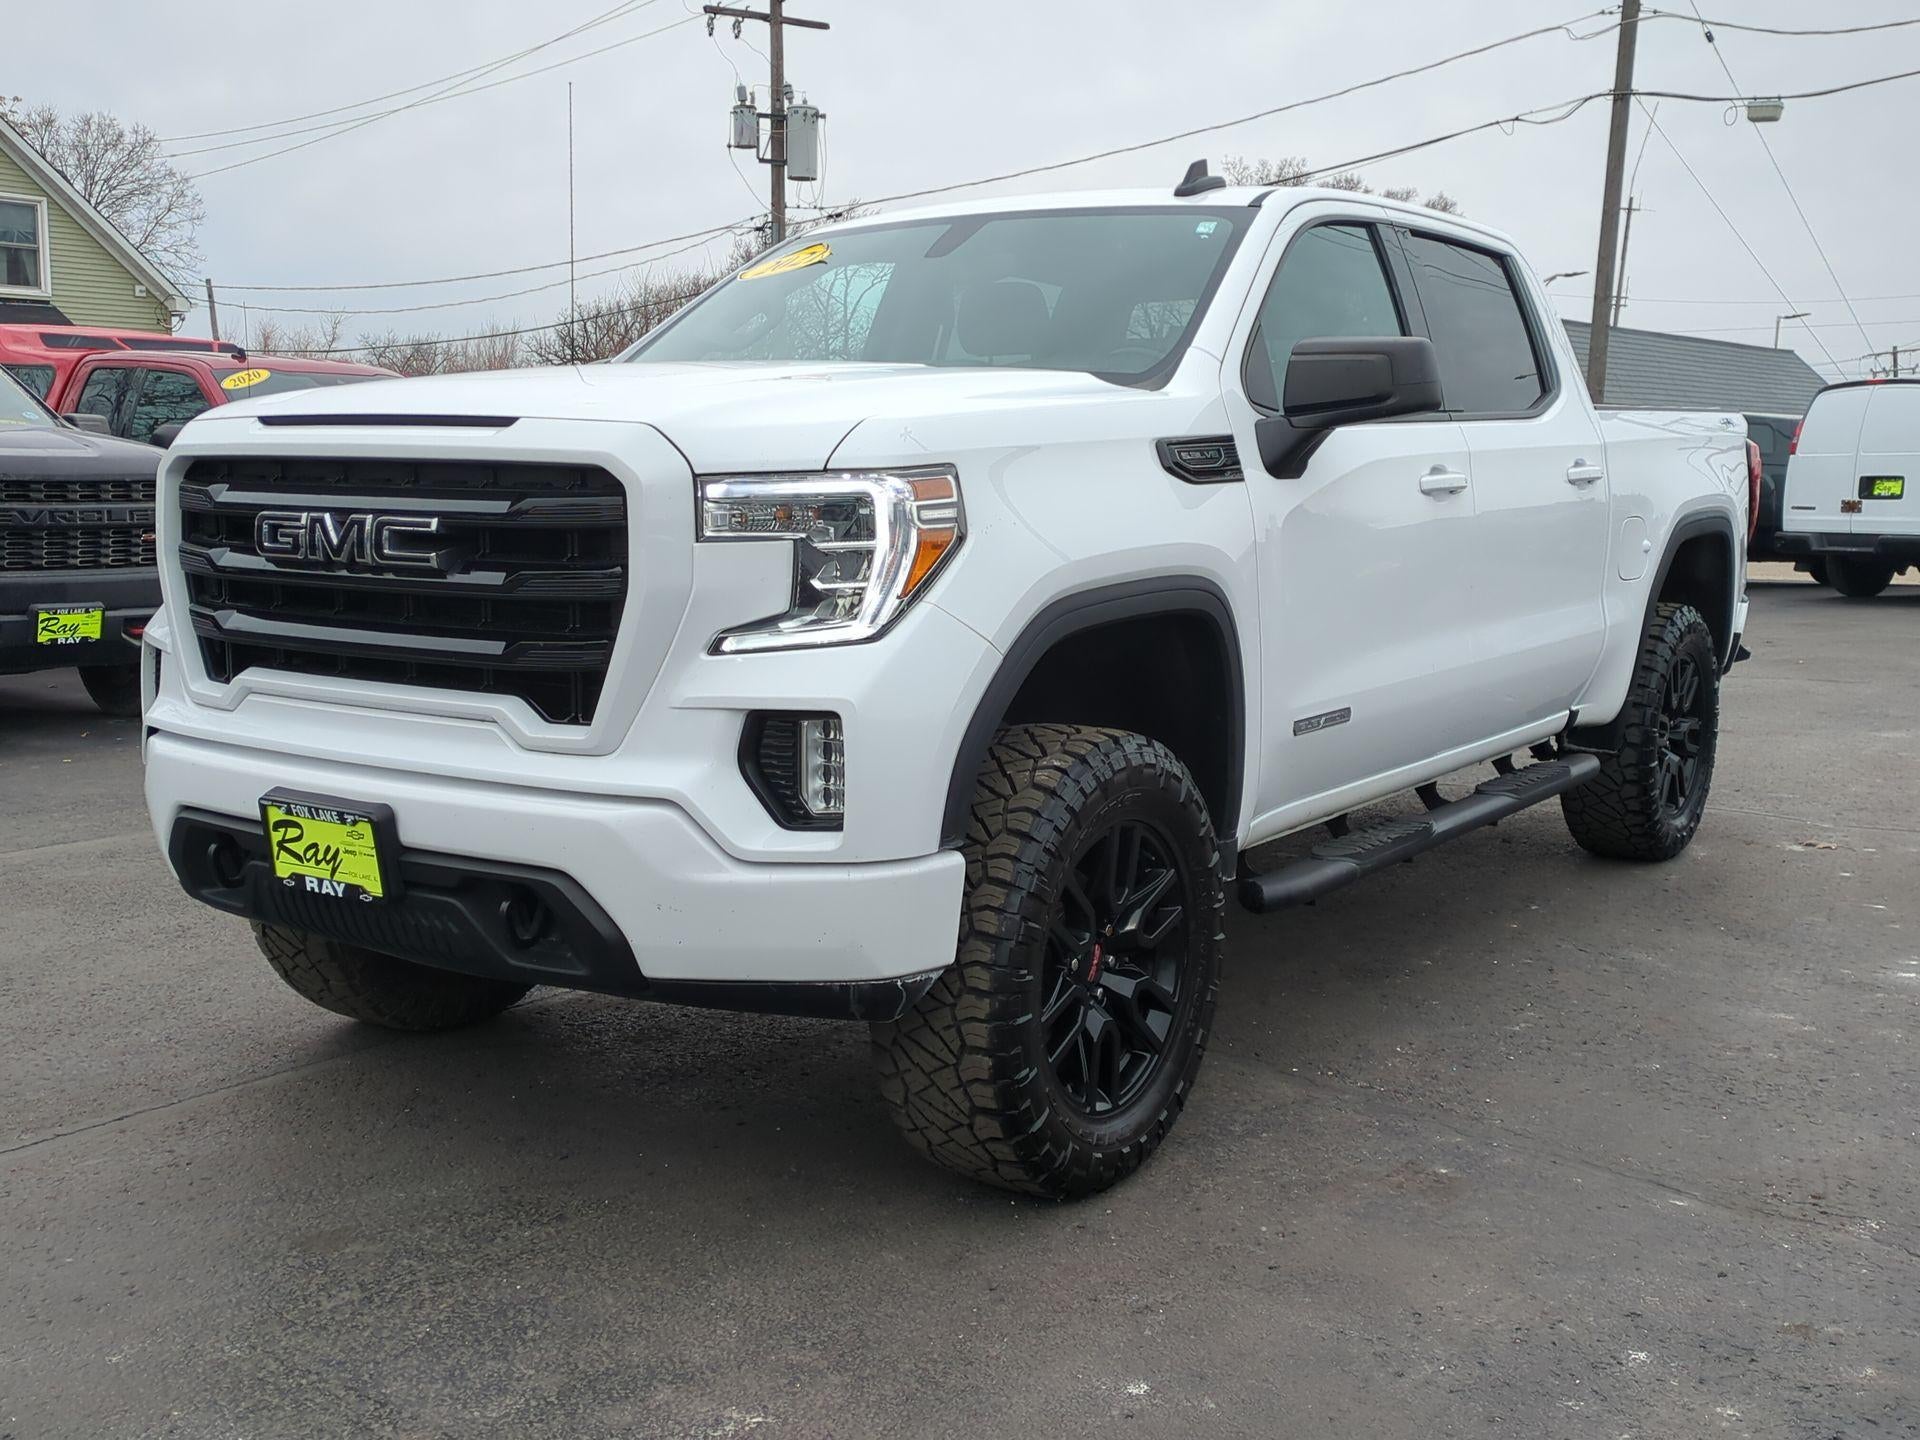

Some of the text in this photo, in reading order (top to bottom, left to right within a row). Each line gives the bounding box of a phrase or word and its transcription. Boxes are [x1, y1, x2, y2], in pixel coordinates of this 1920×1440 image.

[230, 371, 261, 387] 2020
[255, 511, 439, 569] GMC
[39, 616, 80, 637] Ray
[57, 637, 81, 645] RAY
[290, 804, 341, 824] FOX LAKE
[272, 819, 343, 880] Ray
[305, 876, 346, 898] RAY
